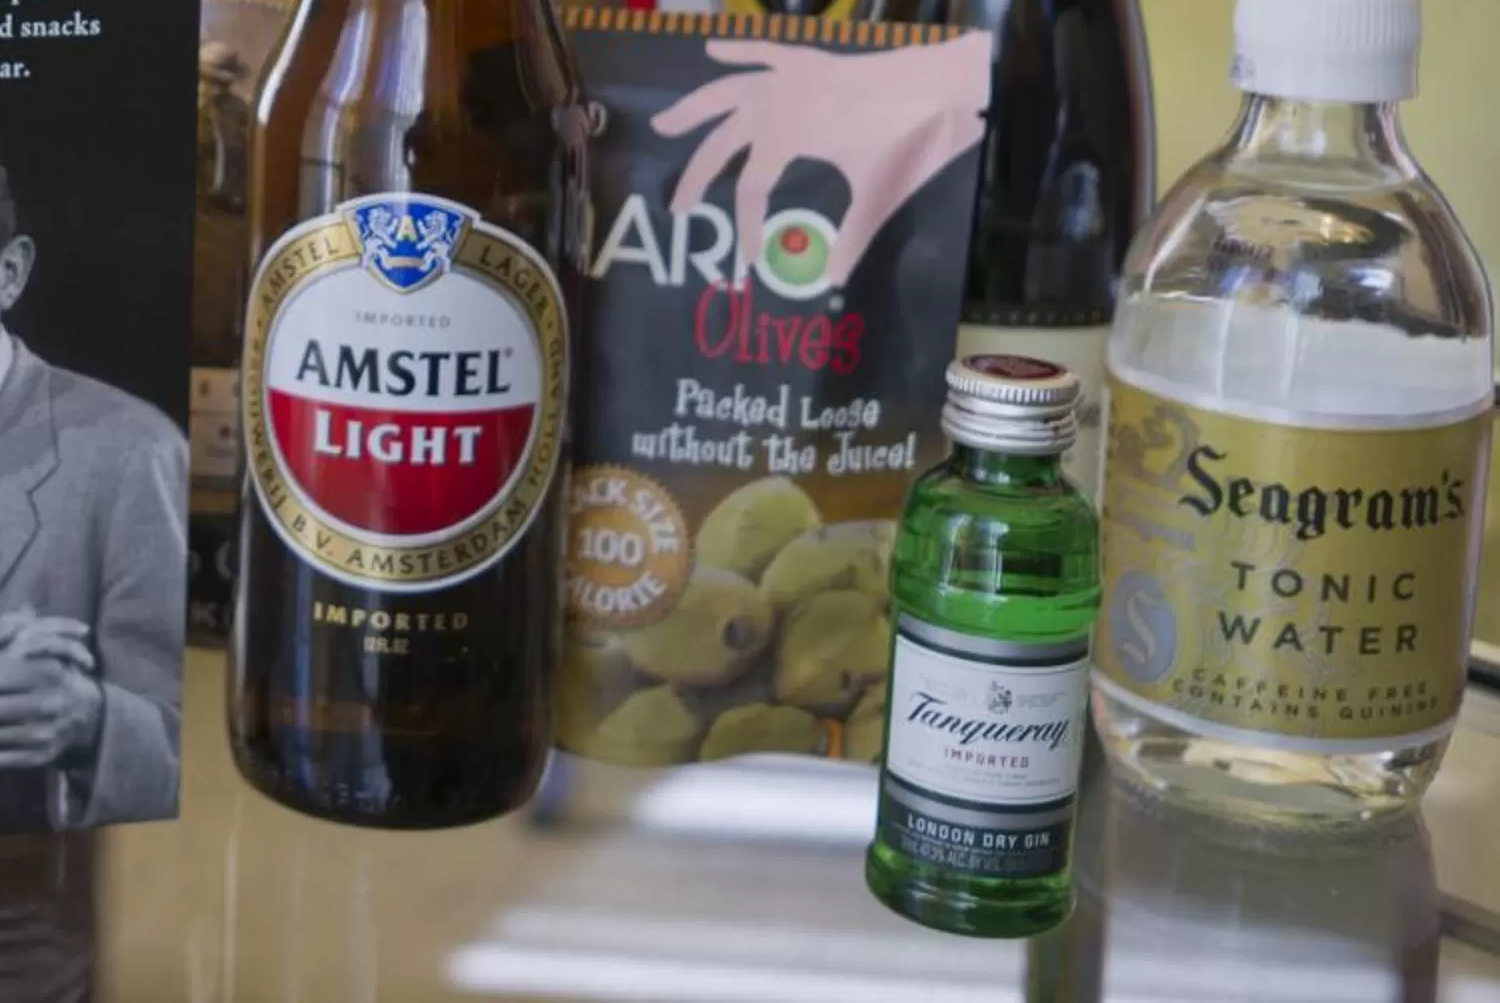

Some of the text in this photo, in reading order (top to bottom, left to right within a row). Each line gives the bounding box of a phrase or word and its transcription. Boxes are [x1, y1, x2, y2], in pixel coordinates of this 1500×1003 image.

[20, 11, 101, 37] snacks
[591, 193, 843, 301] ARIO
[262, 237, 340, 317] AMSTEL
[355, 309, 452, 329] IMPORTED
[694, 276, 866, 374] Olives
[295, 338, 512, 397] AMSTEL
[674, 377, 881, 429] Packed Loose
[313, 408, 485, 467] LIGHT
[631, 422, 754, 469] without
[762, 431, 816, 474] the
[1179, 444, 1466, 540] Seagram's
[345, 500, 528, 575] AMSTERDAM
[580, 528, 645, 568] 100
[1231, 560, 1417, 603] TONIC
[312, 601, 469, 631] IMPORTED
[1217, 610, 1418, 656] WATER
[1172, 678, 1320, 719] CONTAINS
[1192, 668, 1427, 702] CAFFEINE FREE
[907, 691, 1070, 750] Tanqueray
[944, 746, 1030, 768] IMPORTED
[907, 813, 1051, 848] LONDON DRY GIN
